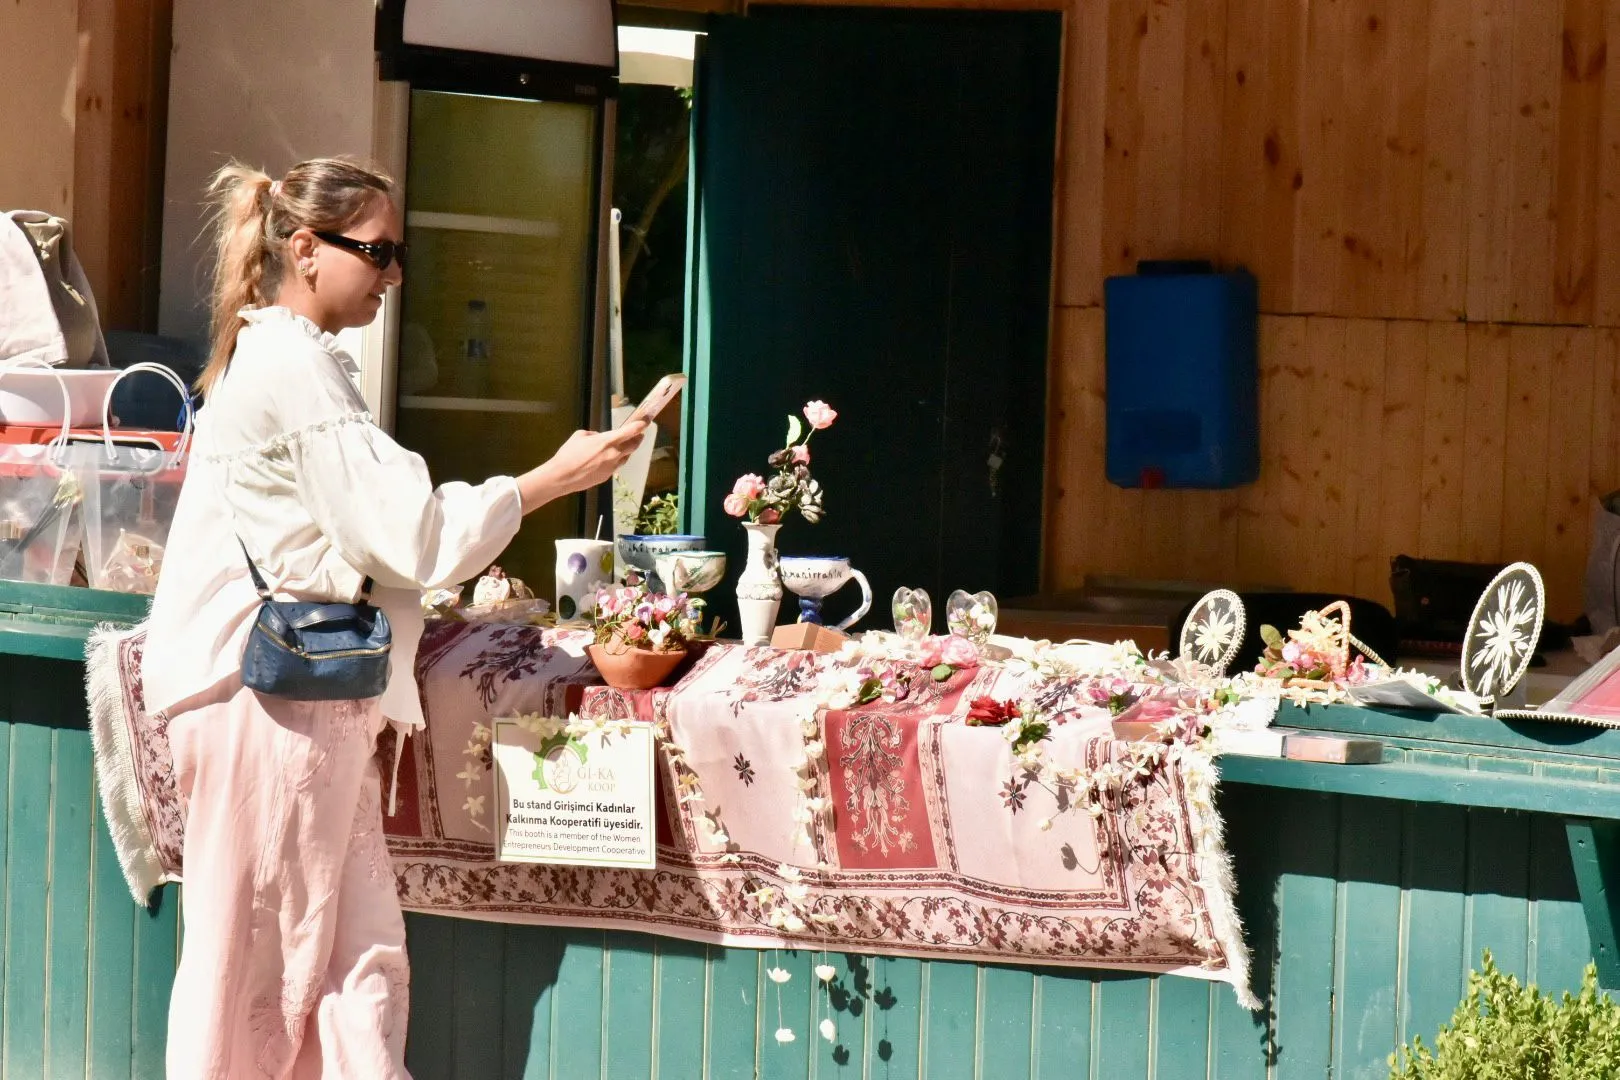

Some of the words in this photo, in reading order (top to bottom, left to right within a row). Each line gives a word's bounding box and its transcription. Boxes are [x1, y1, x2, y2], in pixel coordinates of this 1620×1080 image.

[588, 783, 615, 793] KOOP
[513, 799, 525, 809] Bu
[527, 800, 552, 811] stand
[554, 801, 594, 814] Girişimci
[596, 803, 636, 814] Kadınlar
[506, 814, 548, 825] Kalkınma
[550, 815, 602, 829] Kooperatifi
[603, 817, 644, 830] üyesidir.
[509, 828, 523, 838] This
[524, 829, 545, 839] booth
[546, 830, 553, 839] is
[553, 831, 559, 839] a
[559, 831, 589, 841] member
[590, 831, 599, 841] of
[599, 832, 612, 842] the
[613, 834, 641, 843] Women
[553, 842, 600, 854] Development
[602, 844, 646, 856] Cooperative
